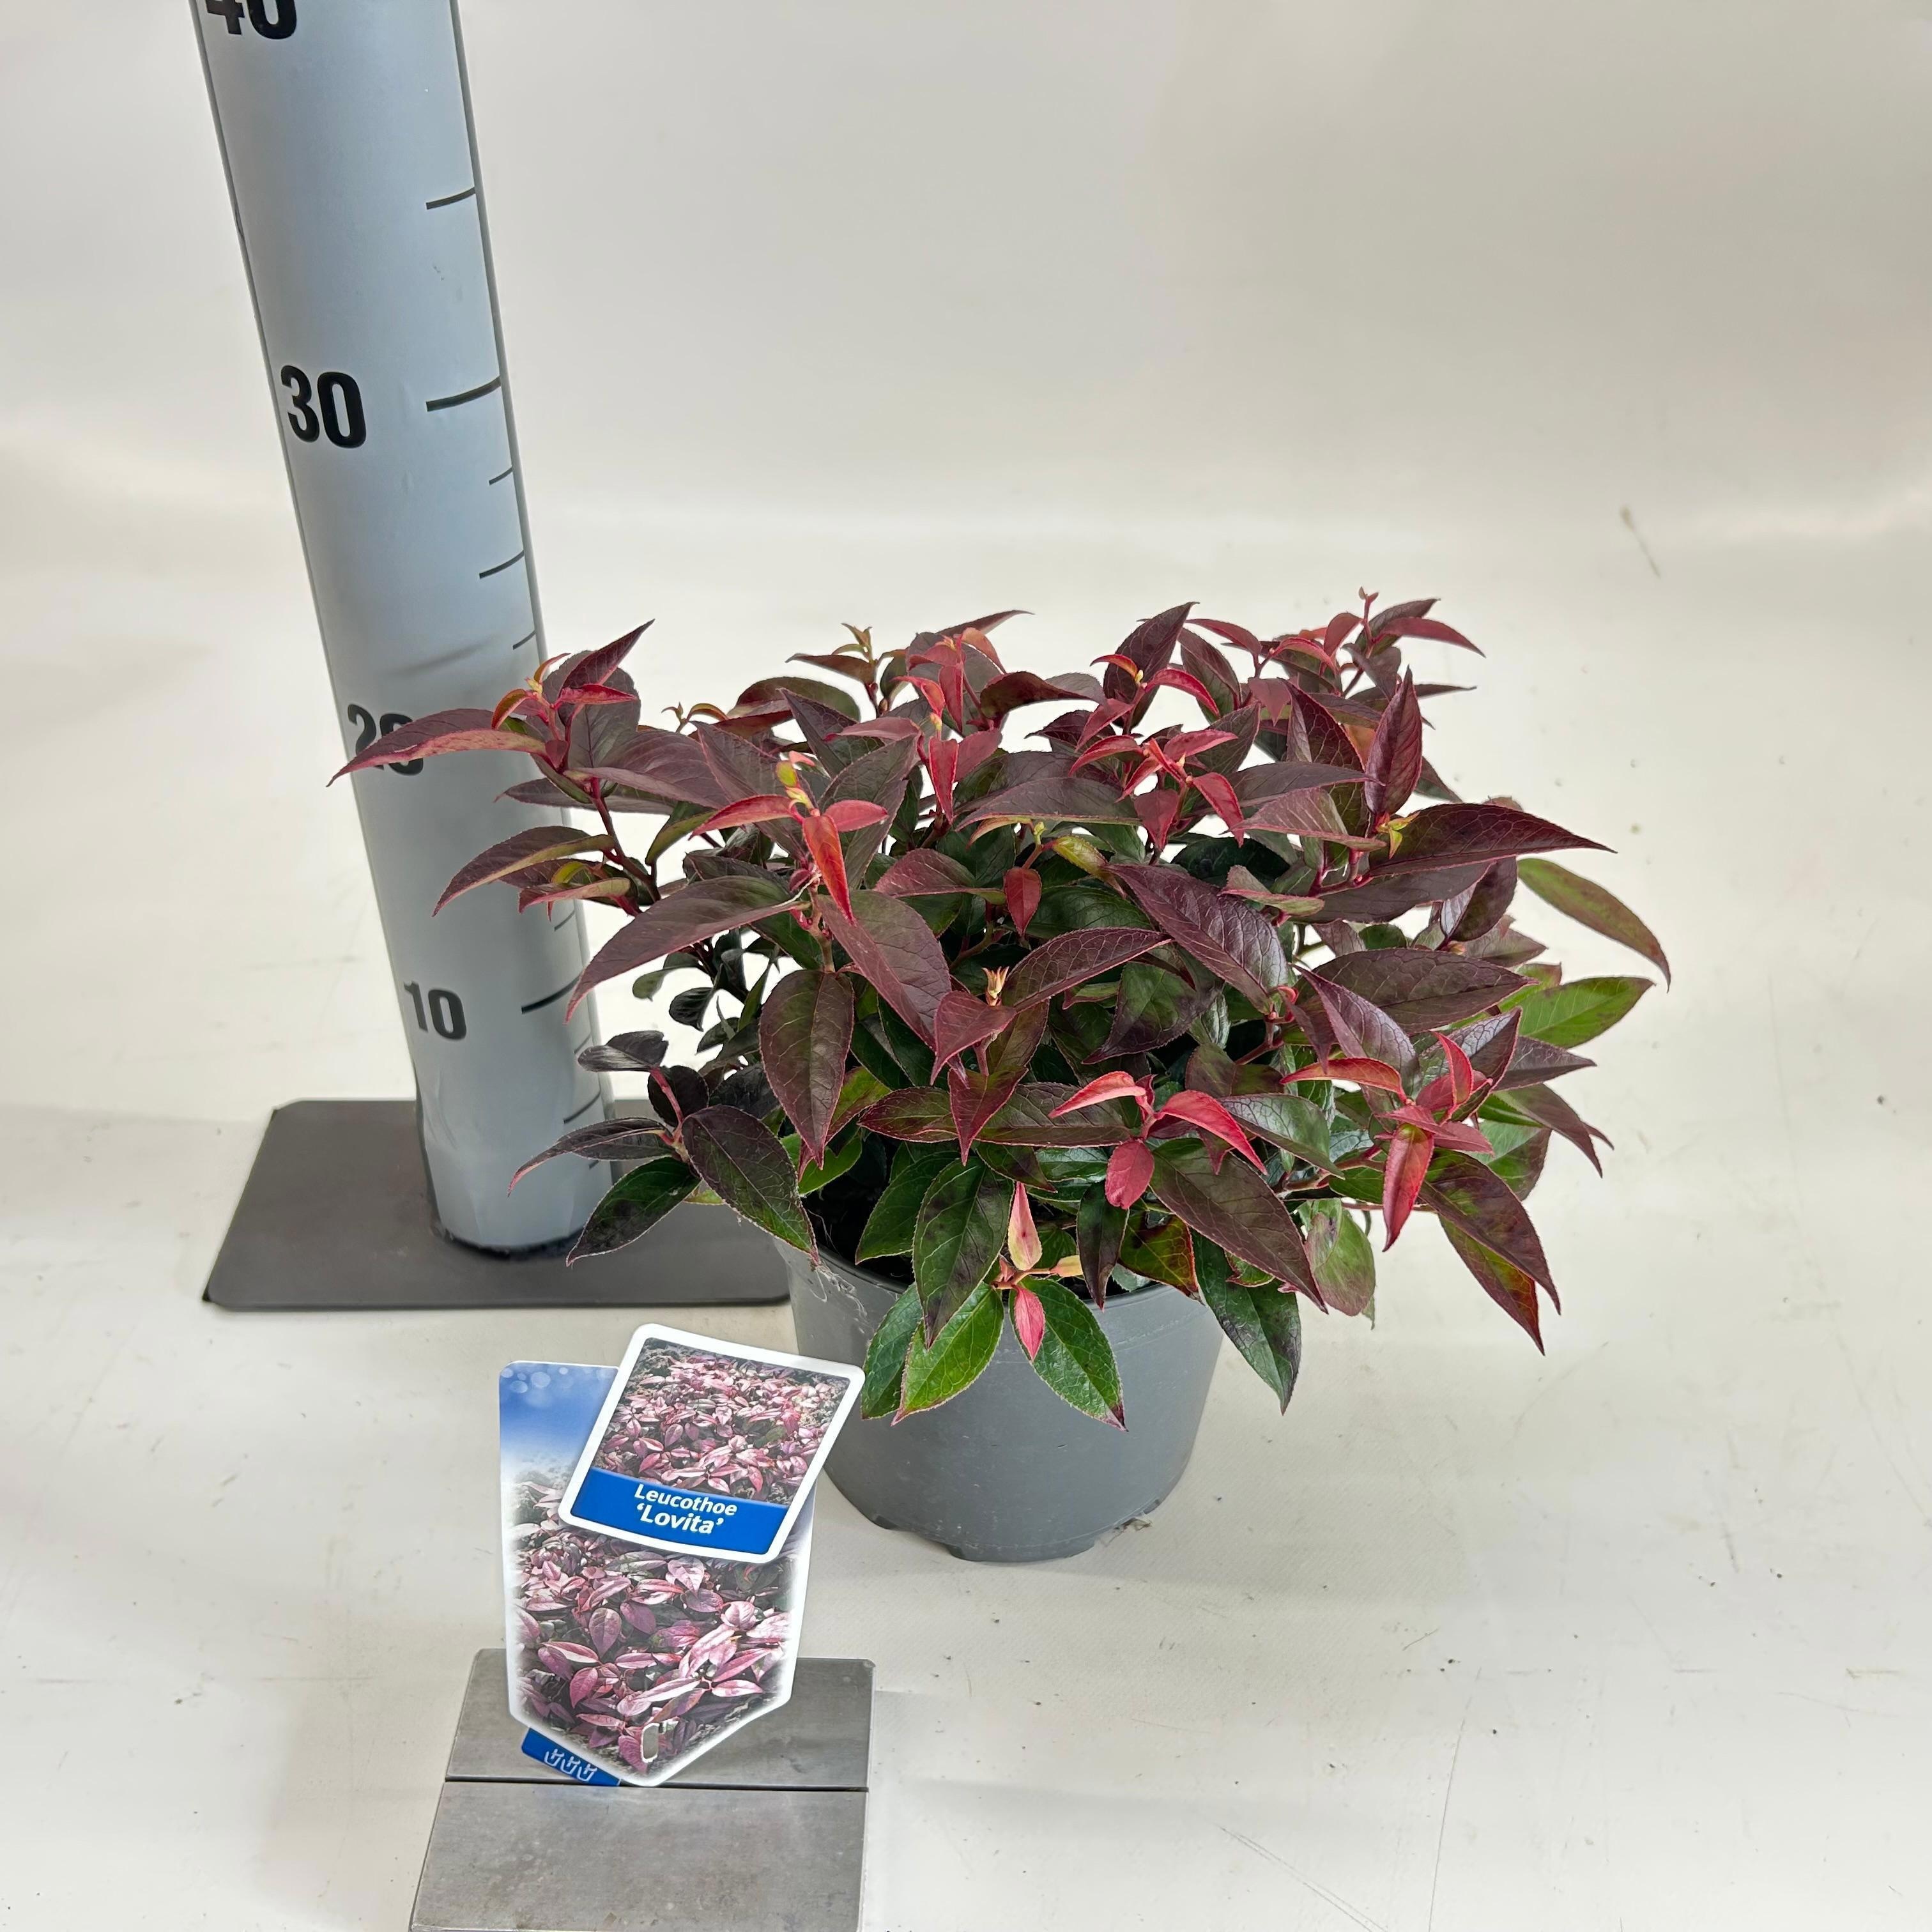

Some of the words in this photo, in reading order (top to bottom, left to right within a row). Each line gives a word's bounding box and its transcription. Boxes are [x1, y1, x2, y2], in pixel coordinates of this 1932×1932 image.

[280, 365, 367, 448] 30
[403, 981, 467, 1041] 10
[634, 1483, 738, 1516] Leucothoe
[636, 1503, 724, 1534] ‘Lovita’
